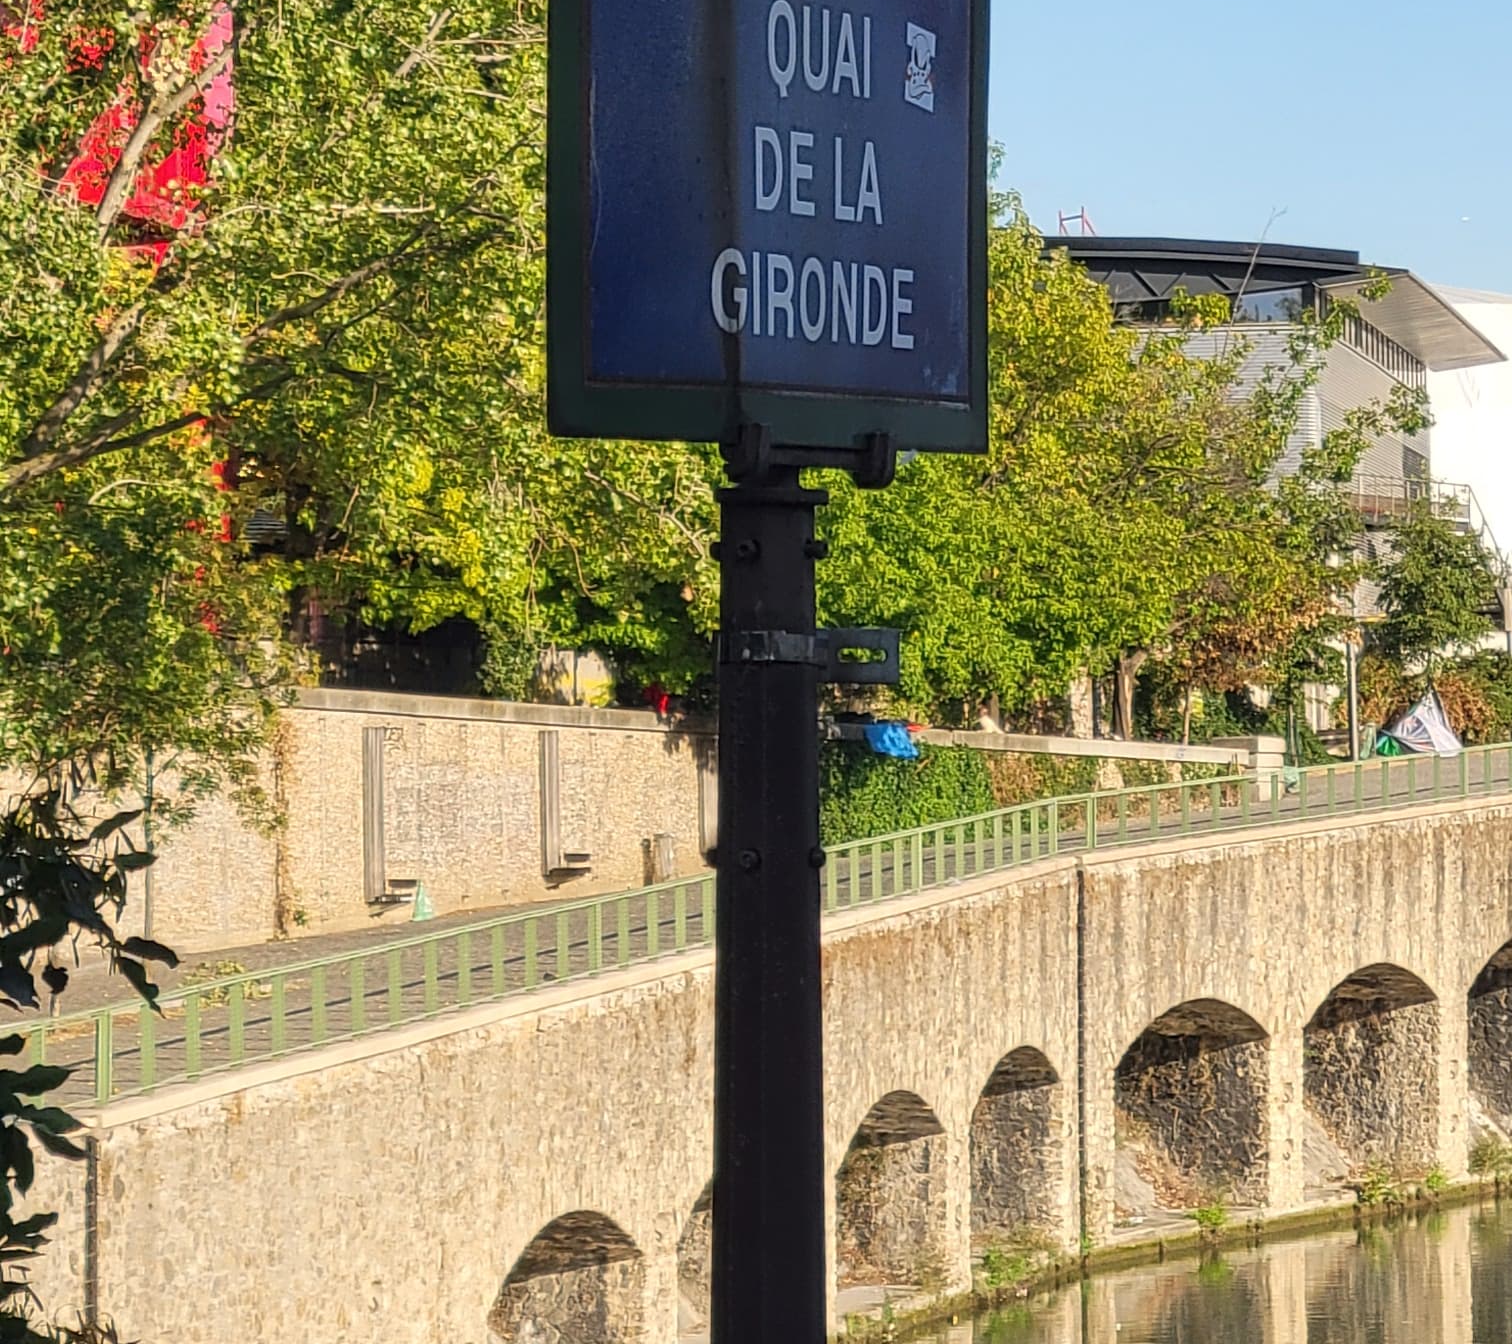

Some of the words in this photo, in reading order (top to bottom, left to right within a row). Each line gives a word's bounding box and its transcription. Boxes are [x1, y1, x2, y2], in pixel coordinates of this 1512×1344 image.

[767, 0, 871, 99] QUAI
[755, 126, 816, 217] DE
[834, 136, 883, 225] LA
[711, 247, 915, 350] GIRONDE
